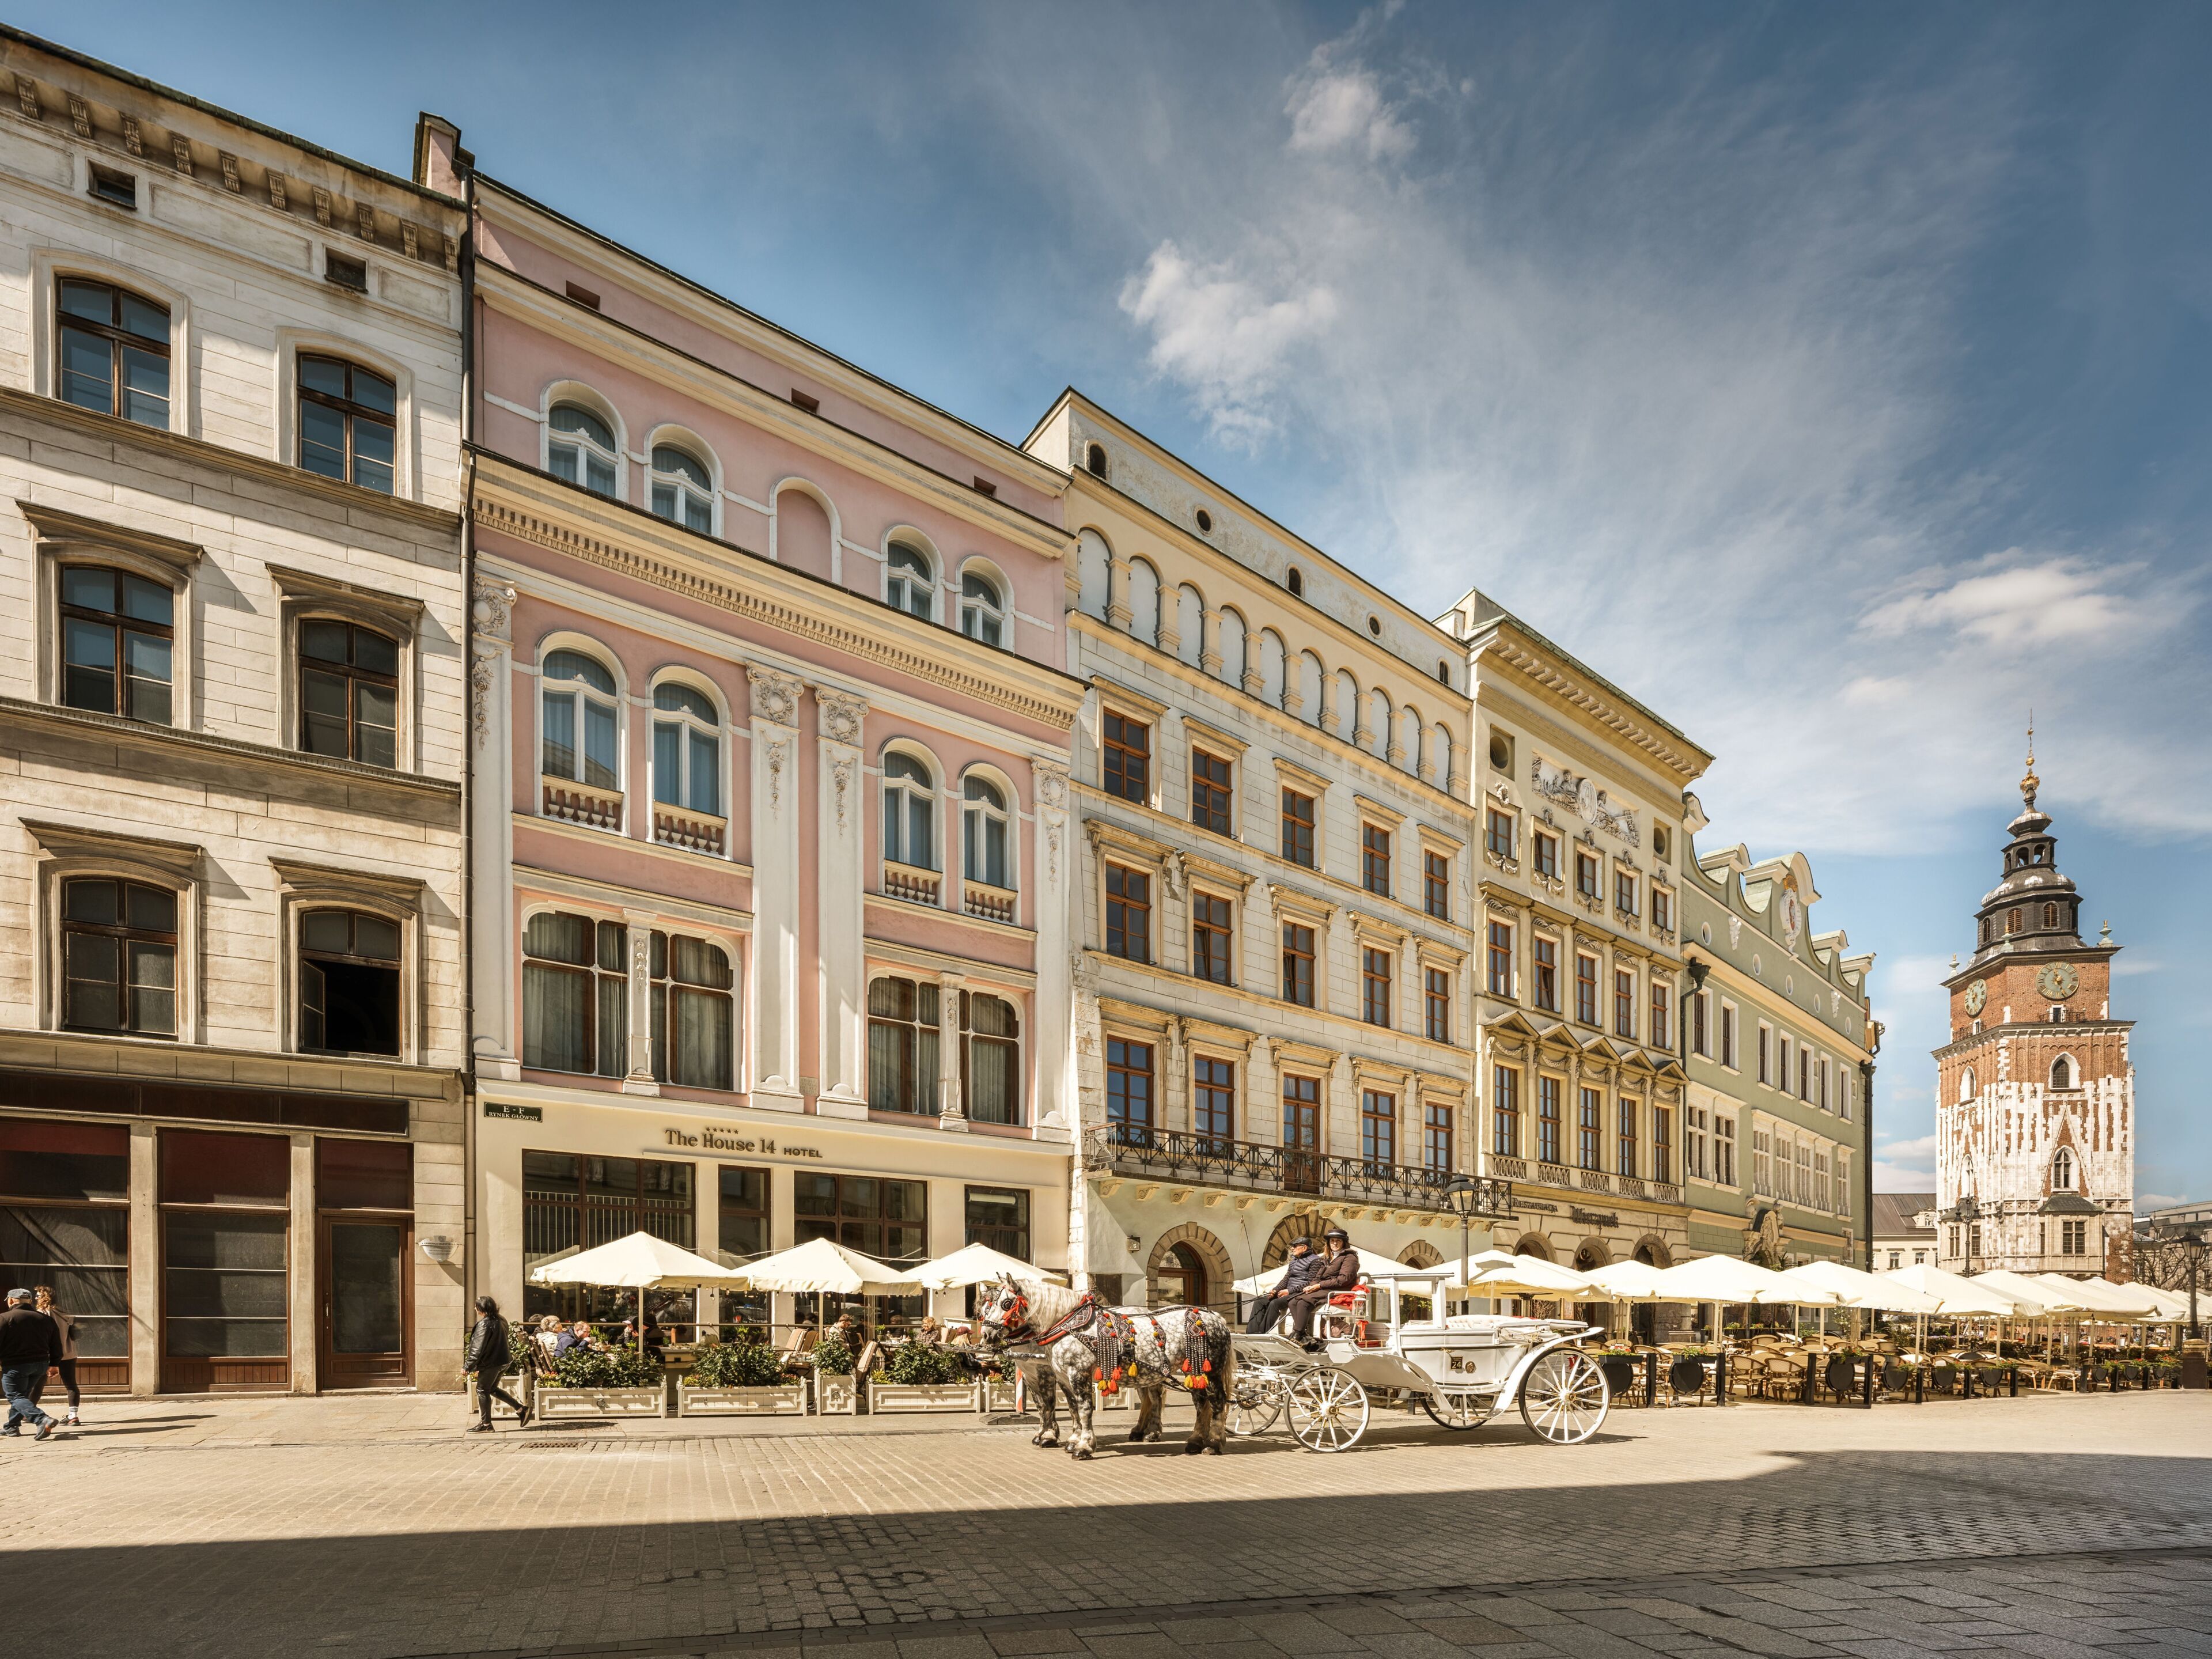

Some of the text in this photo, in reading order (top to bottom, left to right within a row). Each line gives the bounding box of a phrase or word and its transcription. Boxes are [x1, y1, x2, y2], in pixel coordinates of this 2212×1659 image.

[665, 1130, 777, 1154] The House 14
[784, 1147, 823, 1158] HOTEL
